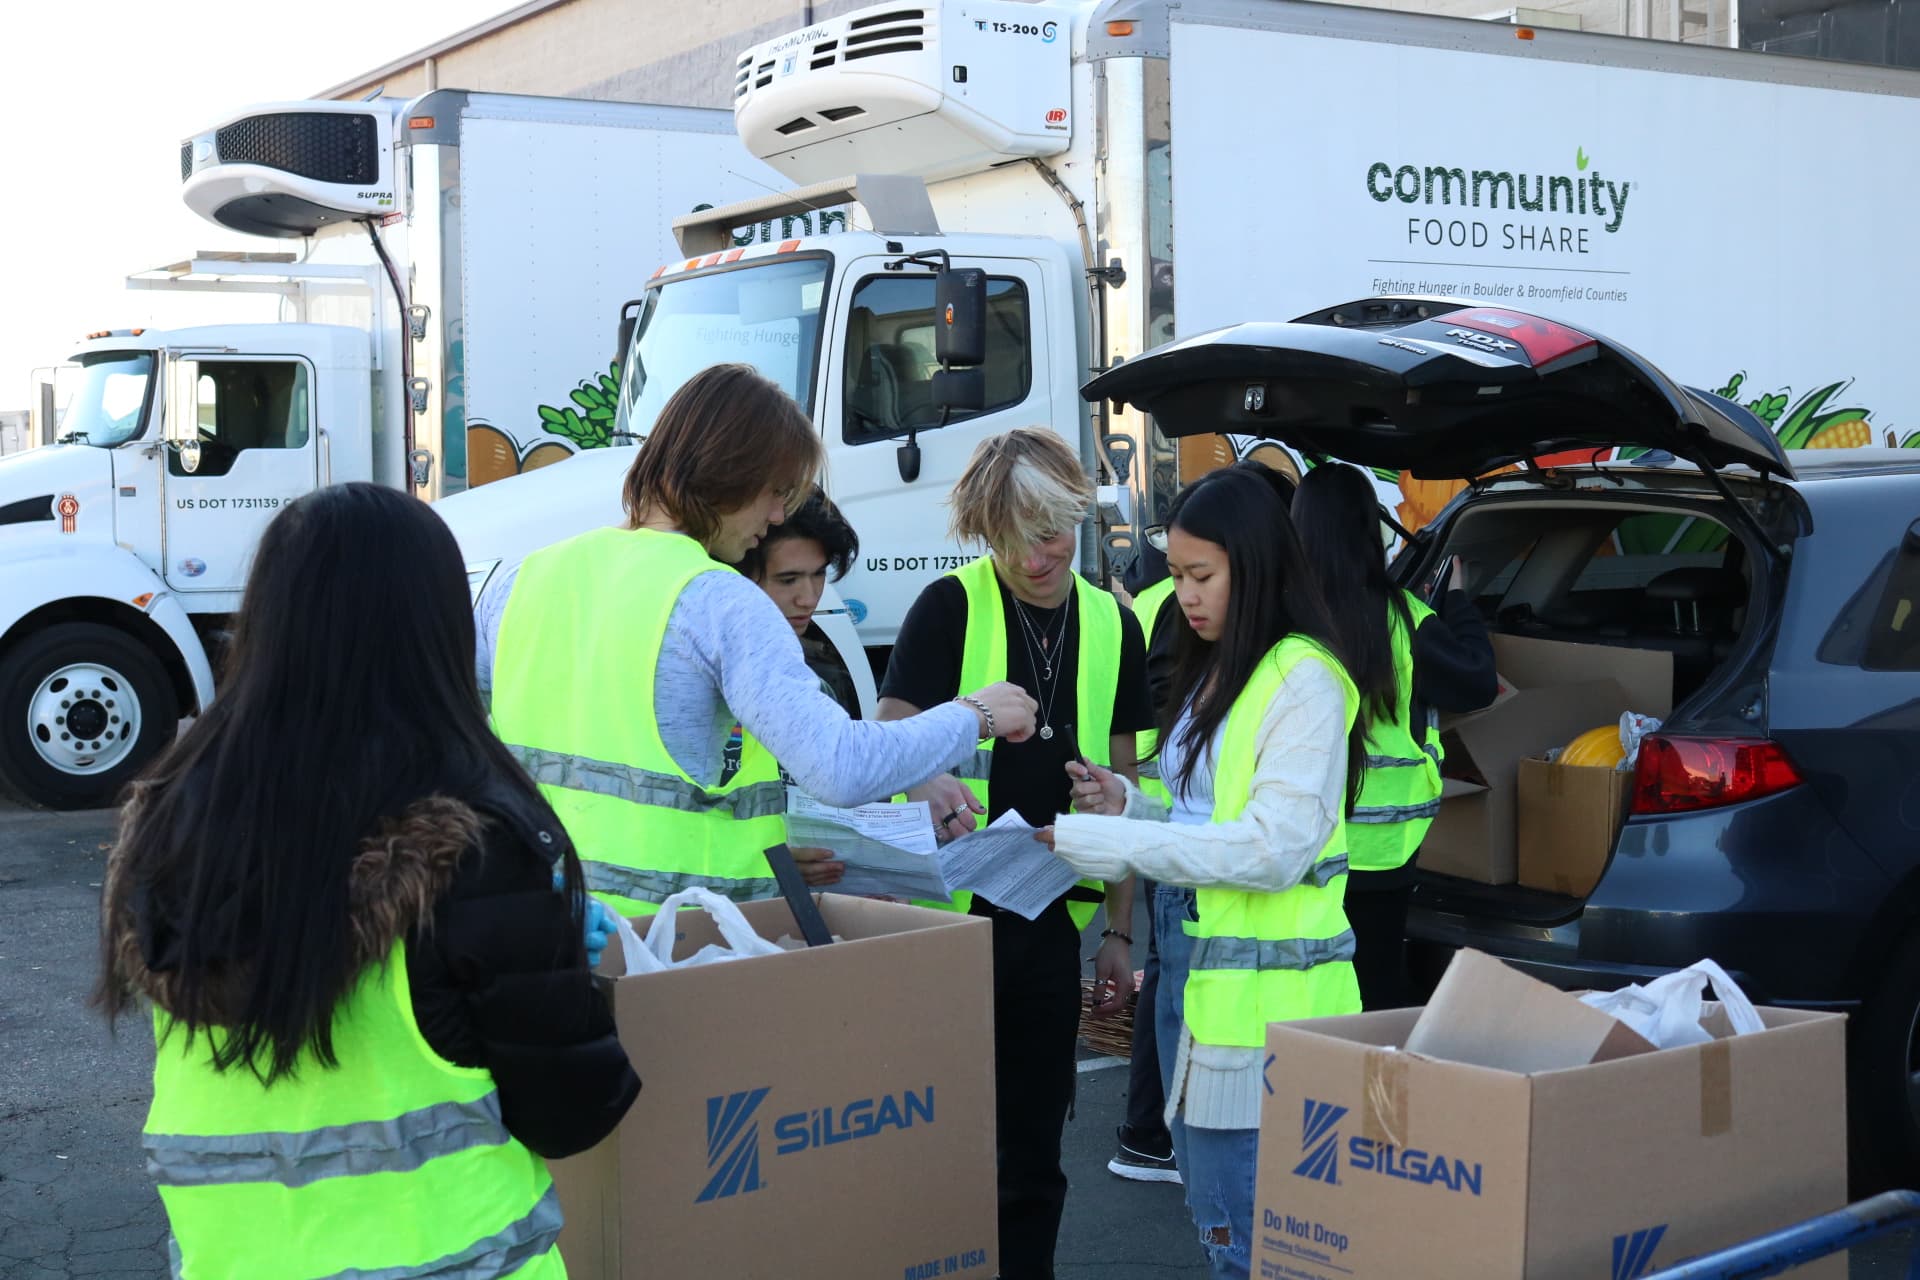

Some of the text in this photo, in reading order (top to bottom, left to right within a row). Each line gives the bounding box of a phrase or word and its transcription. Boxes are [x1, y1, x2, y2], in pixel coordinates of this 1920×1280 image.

[993, 22, 1039, 36] TS-200
[357, 191, 393, 199] SUPRA
[1367, 148, 1630, 233] community
[1408, 218, 1589, 253] FOOD SHARE
[1373, 278, 1628, 303] Fighting Hunger in Boulder & Broomfield Counties
[754, 328, 800, 347] Hunge
[1445, 329, 1517, 352] RDX
[177, 499, 194, 509] US
[200, 499, 227, 509] DOT
[232, 498, 279, 509] 1731139
[866, 558, 888, 572] US
[894, 557, 928, 571] DOT
[1264, 1208, 1348, 1253] Do Not Drop
[905, 1247, 986, 1280] MADE IN USA
